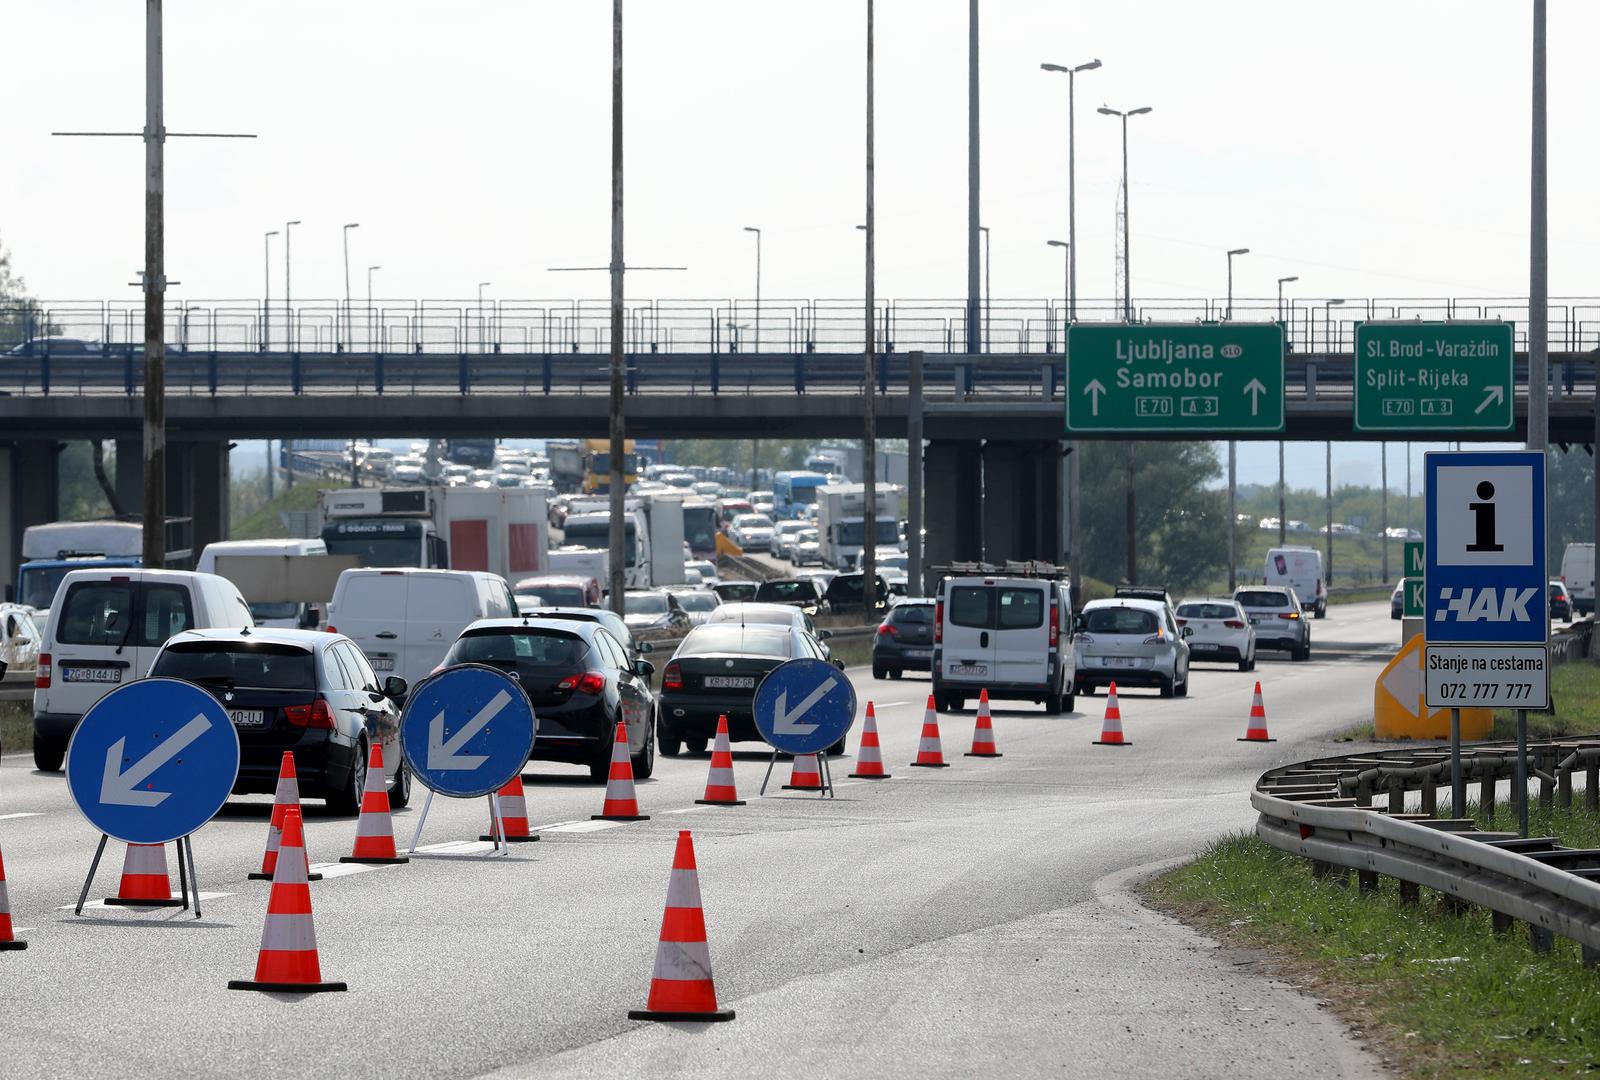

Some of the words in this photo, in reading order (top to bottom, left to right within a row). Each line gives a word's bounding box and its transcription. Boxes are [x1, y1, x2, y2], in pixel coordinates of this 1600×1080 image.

[1116, 339, 1214, 364] Ljubljana
[1222, 346, 1241, 356] SLO
[1367, 340, 1385, 357] Sl.
[1116, 367, 1224, 389] Samobor
[1434, 587, 1539, 622] HAK
[1430, 654, 1468, 674] Stanje
[1472, 658, 1487, 671] na
[1490, 655, 1543, 671] cestama
[1440, 683, 1467, 699] 072
[1472, 683, 1499, 699] 777
[1506, 683, 1532, 699] 777
